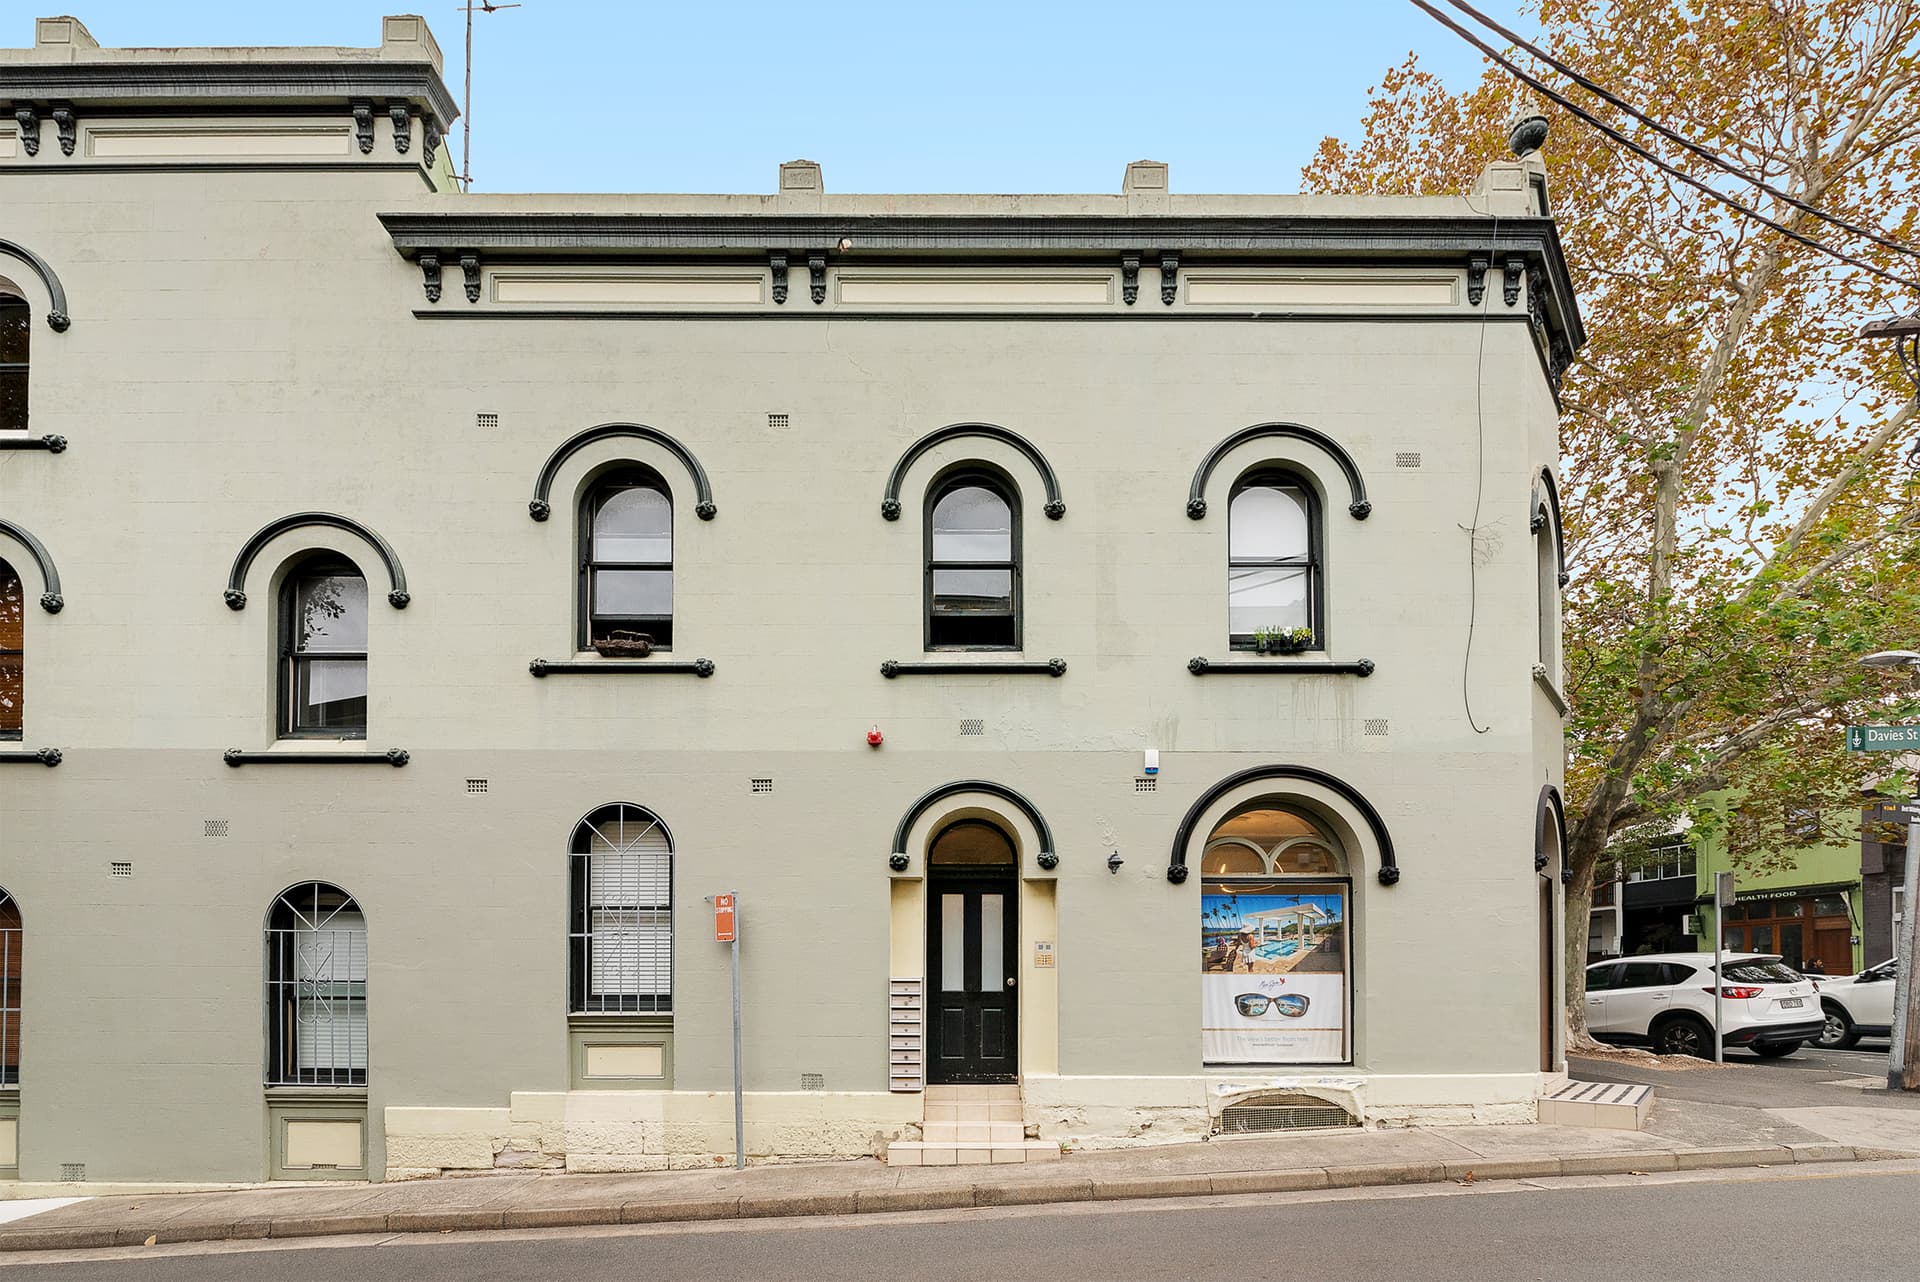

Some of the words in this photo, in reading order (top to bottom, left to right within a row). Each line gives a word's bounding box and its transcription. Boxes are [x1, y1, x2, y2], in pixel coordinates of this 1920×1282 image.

[1868, 729, 1904, 742] Davies
[1906, 728, 1919, 740] St
[720, 897, 728, 906] NO
[1735, 893, 1768, 902] HEALTH
[1770, 891, 1797, 899] FOOD
